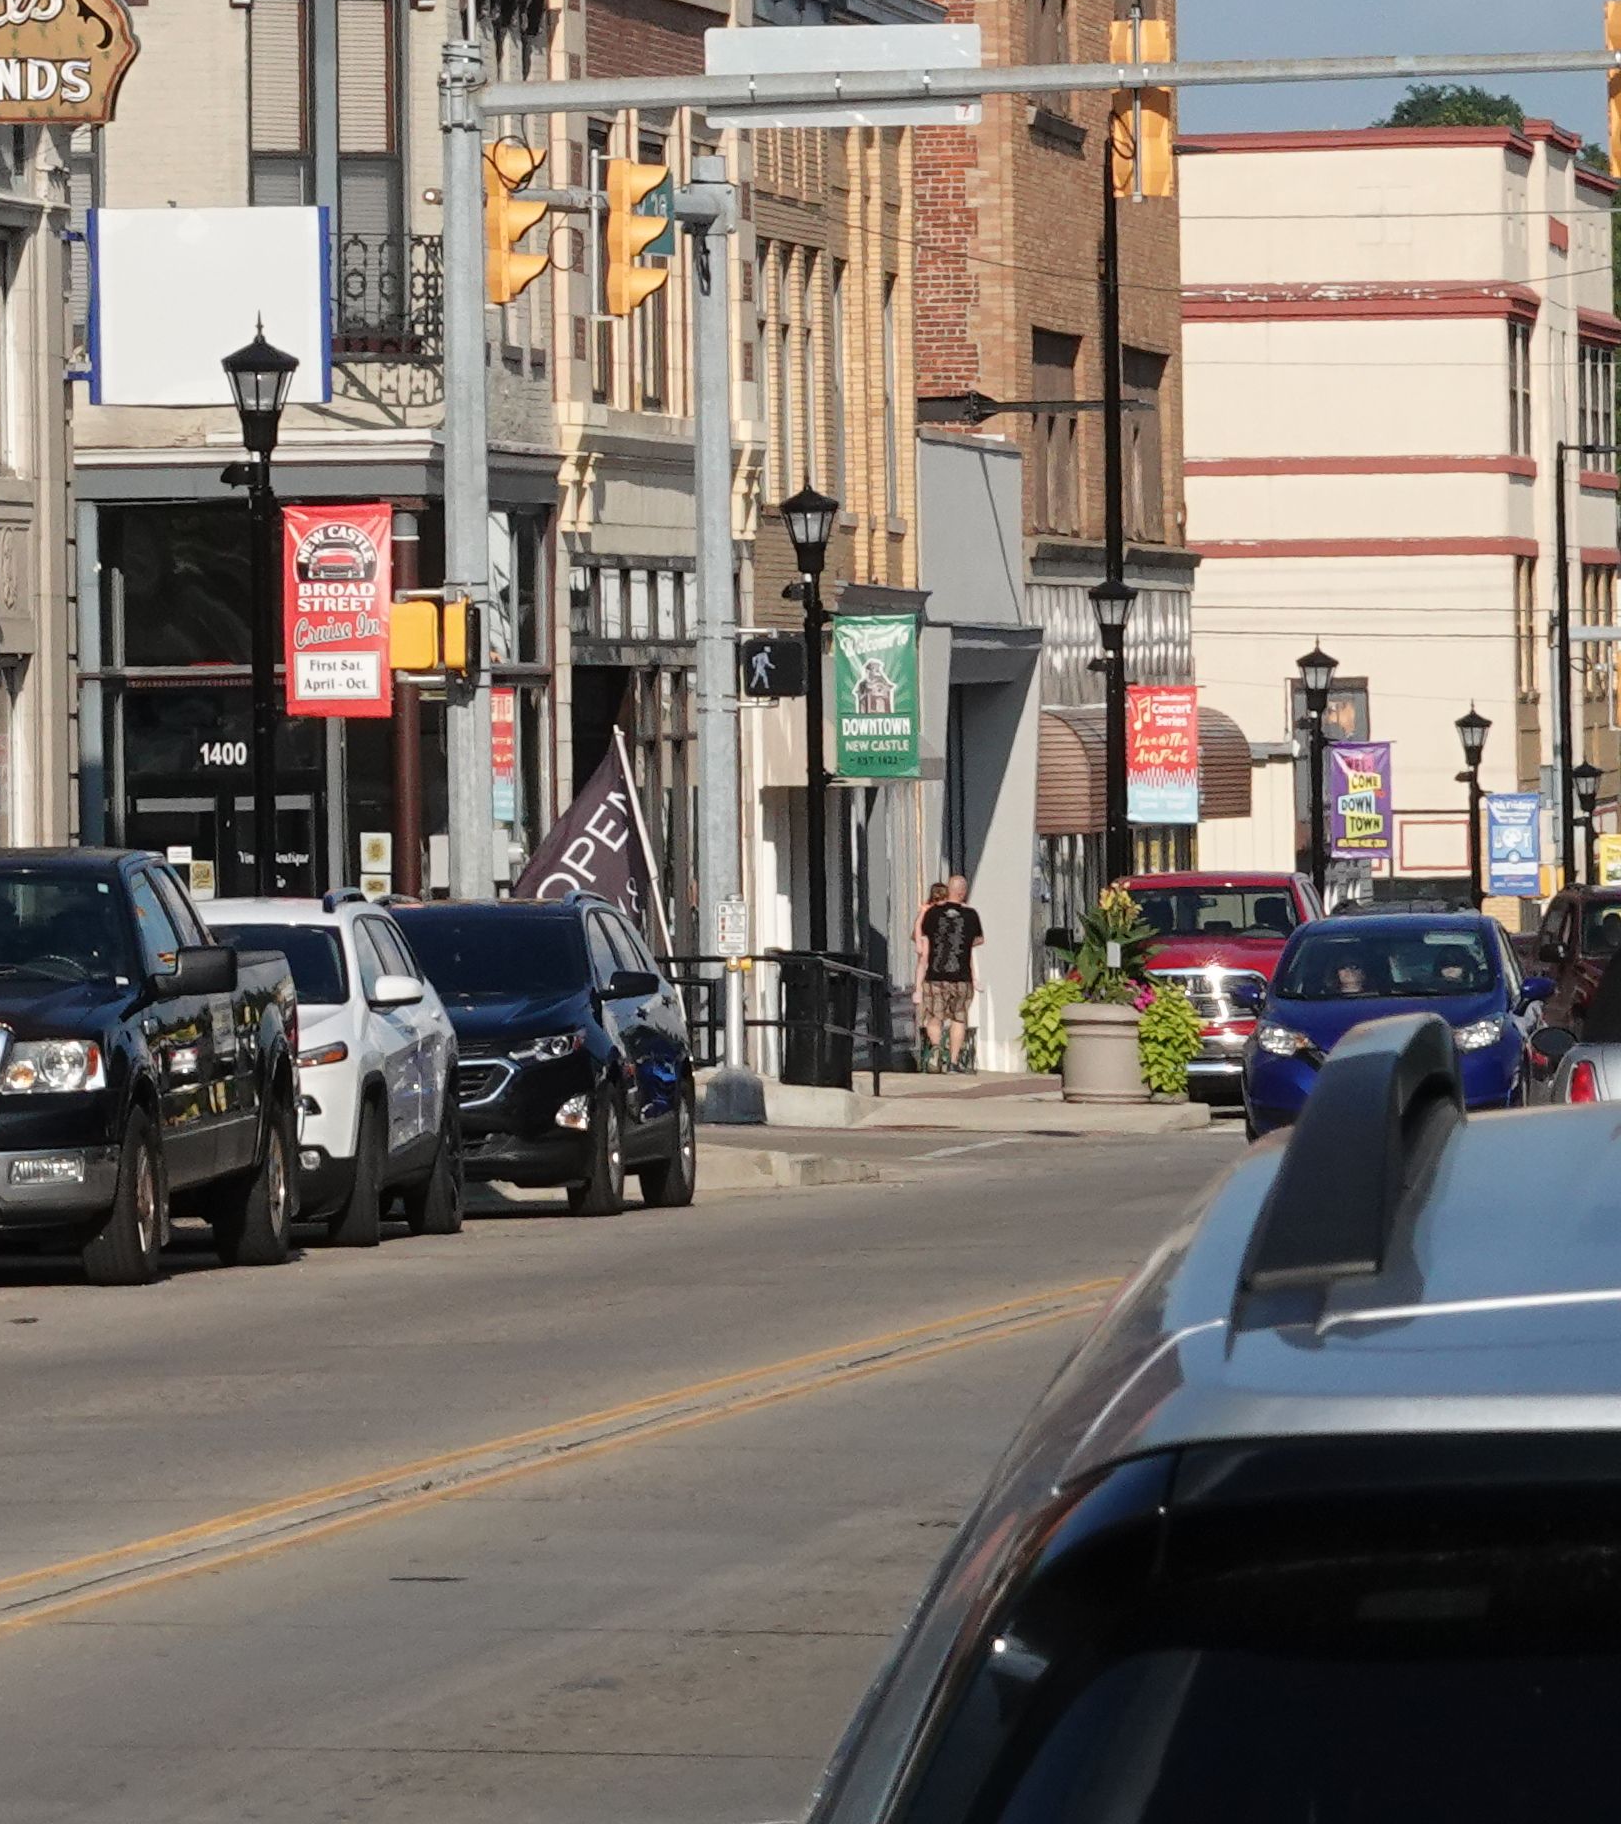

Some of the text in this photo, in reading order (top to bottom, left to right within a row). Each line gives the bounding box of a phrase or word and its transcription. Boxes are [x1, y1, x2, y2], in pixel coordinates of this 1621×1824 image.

[296, 523, 377, 564] NEW CASTLE
[297, 583, 377, 597] BROAD
[297, 597, 375, 612] STREET
[294, 612, 380, 650] Cruise In
[309, 659, 337, 672] First
[303, 677, 335, 692] April
[1151, 703, 1192, 714] Concert
[842, 717, 911, 737] DOWNTOWN
[1155, 716, 1188, 727] Series
[845, 739, 910, 753] NEW CASTLE
[199, 742, 248, 766] 1400
[1341, 795, 1373, 814] DOWN
[1349, 816, 1380, 832] TOWN
